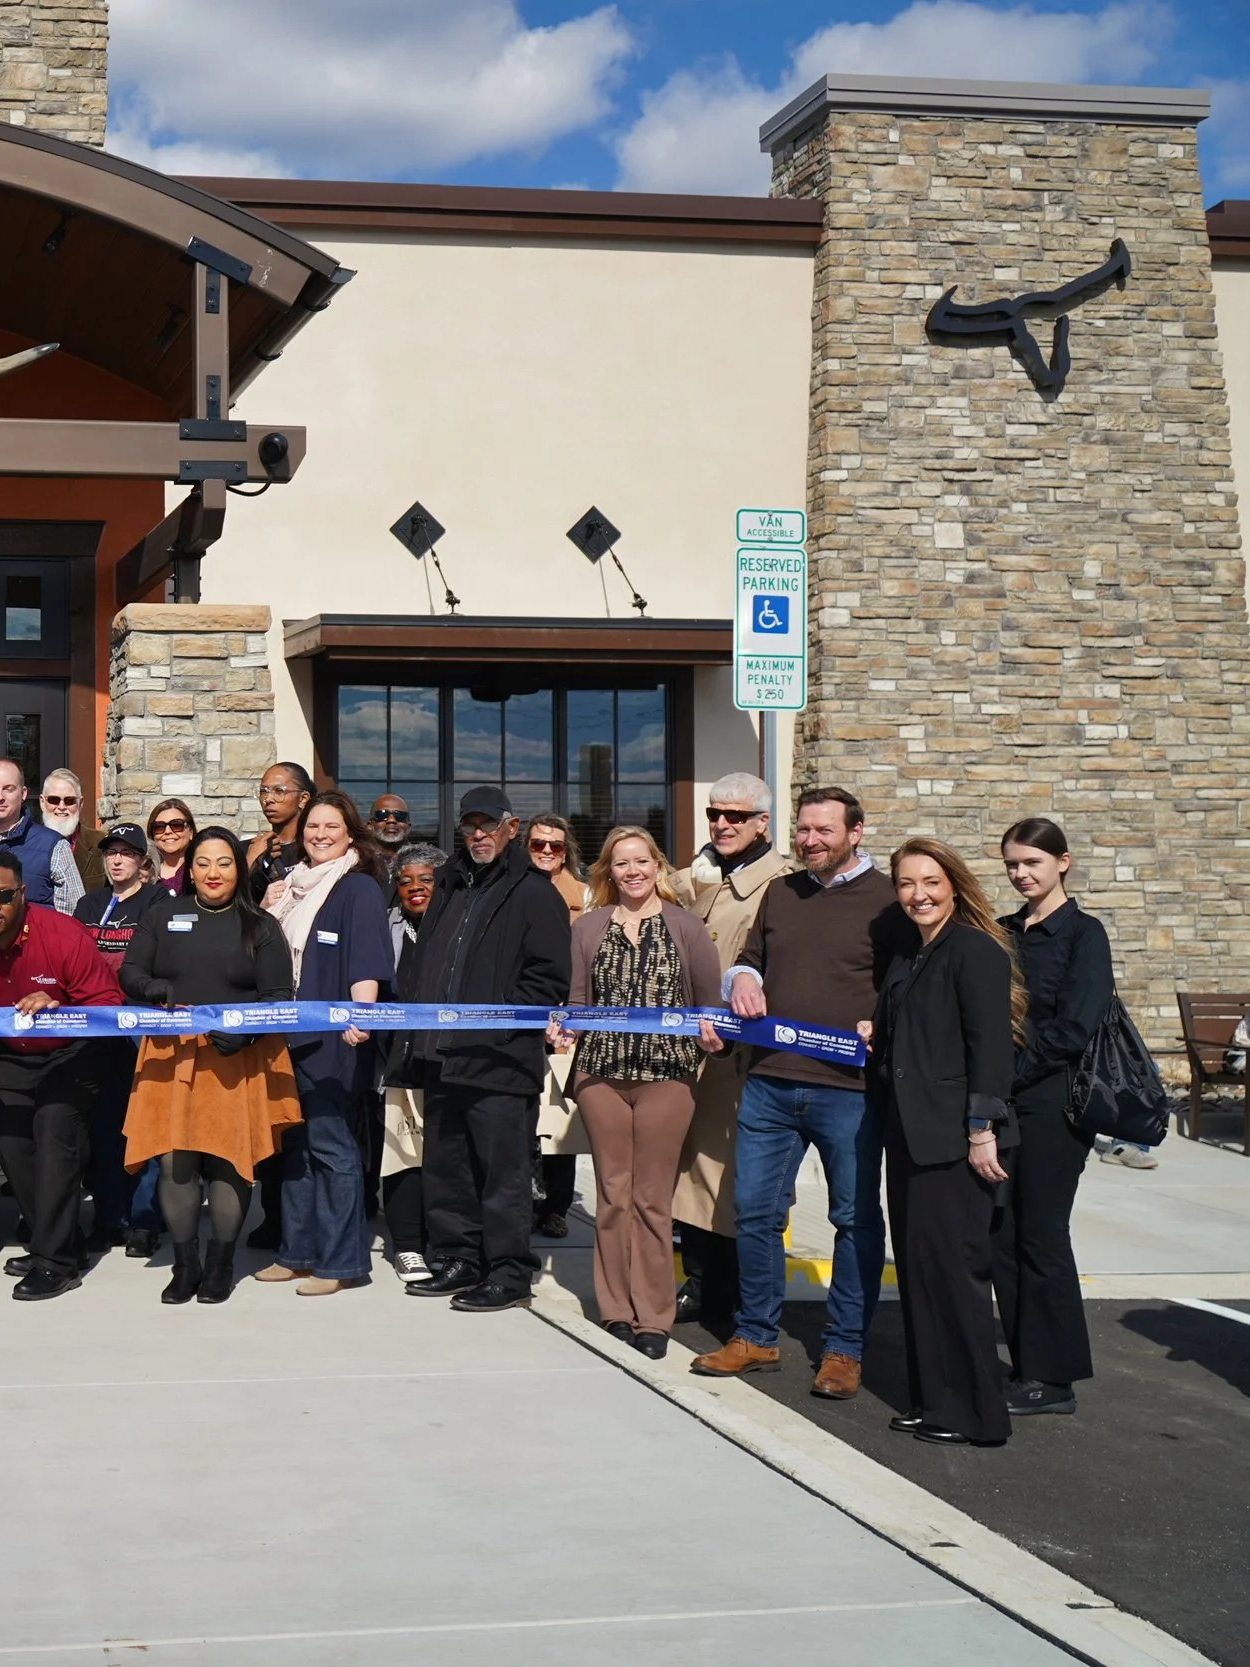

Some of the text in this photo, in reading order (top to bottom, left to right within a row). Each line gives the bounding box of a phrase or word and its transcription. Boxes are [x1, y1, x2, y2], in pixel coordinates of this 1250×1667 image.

[759, 516, 782, 527] VAN
[747, 529, 794, 537] ACCESSIBLE
[740, 558, 801, 572] RESERVED
[743, 577, 799, 591] PARKING
[746, 660, 794, 671] MAXIMUM
[748, 674, 793, 685] PENALTY
[686, 1014, 722, 1022] TRIANGLE
[798, 1030, 858, 1046] TRIANGLE EAST
[798, 1037, 821, 1045] Chamber
[829, 1042, 856, 1051] Commerce
